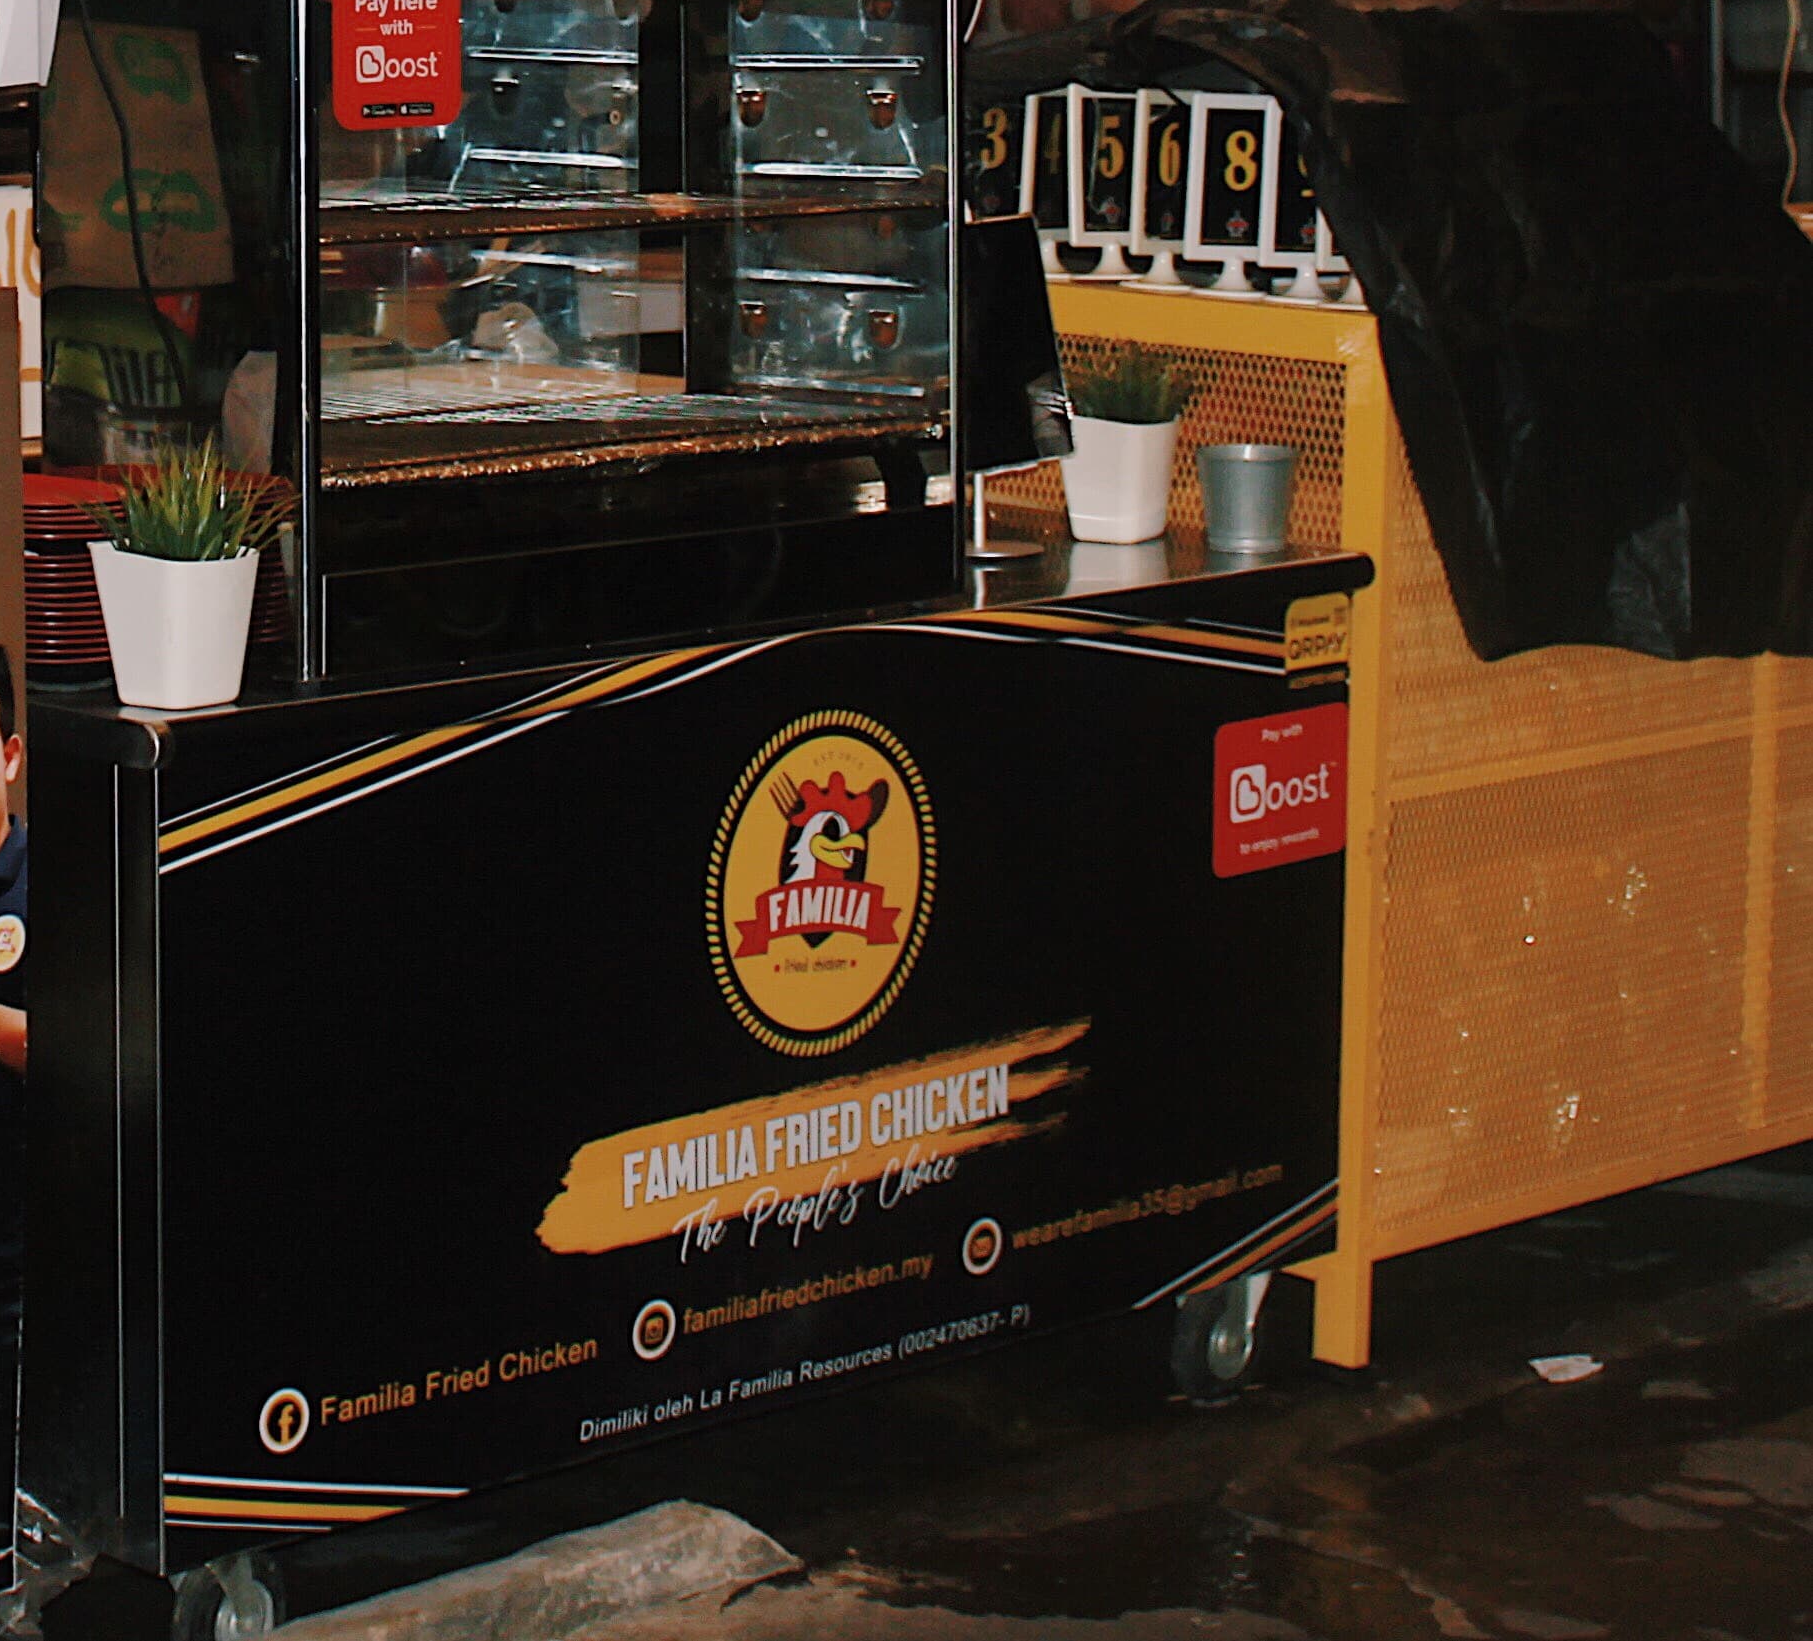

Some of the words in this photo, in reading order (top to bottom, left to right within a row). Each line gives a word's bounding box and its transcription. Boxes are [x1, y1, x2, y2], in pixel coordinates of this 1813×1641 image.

[379, 19, 414, 37] with
[356, 45, 439, 83] Boost
[980, 107, 1009, 170] 3
[1097, 115, 1126, 180] 5
[1158, 122, 1182, 187] 6
[1223, 129, 1258, 192] 8
[1230, 762, 1330, 824] Boost
[768, 885, 872, 933] FAMILIA
[622, 1126, 759, 1210] FAMILIA
[764, 1100, 863, 1174] FRIED
[869, 1063, 1009, 1147] CHICKEN
[672, 1196, 728, 1264] The
[743, 1161, 866, 1249] People's
[879, 1144, 959, 1211] Choice
[684, 1254, 934, 1335] familiafriedchicken.my
[319, 1382, 417, 1427] Familia
[426, 1361, 491, 1402] Fried
[498, 1336, 599, 1383] Chicken
[579, 1407, 649, 1444] Dimiliki
[654, 1395, 693, 1424] oleh
[700, 1387, 722, 1410] La
[728, 1367, 794, 1402] Familia
[798, 1341, 893, 1384] Resources
